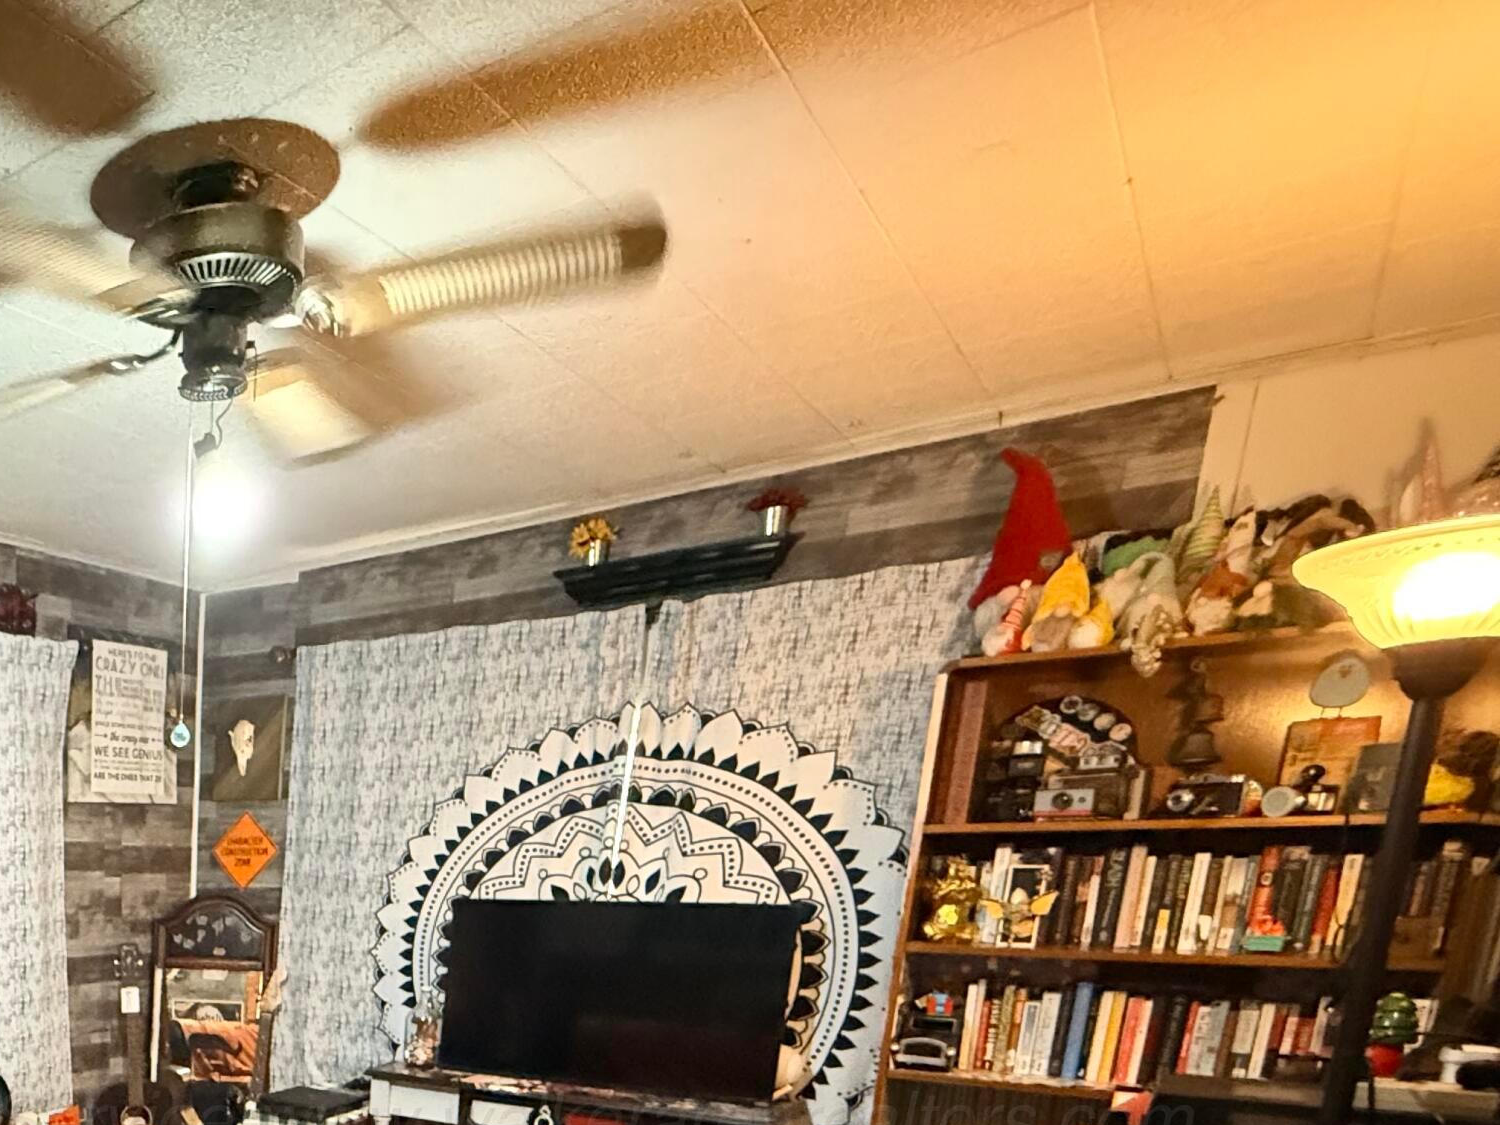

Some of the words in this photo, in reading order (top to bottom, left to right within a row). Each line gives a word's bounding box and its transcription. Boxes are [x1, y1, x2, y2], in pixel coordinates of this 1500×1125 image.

[95, 656, 136, 675] CRAZY
[94, 745, 109, 757] WE
[112, 746, 130, 759] SEE
[132, 748, 163, 761] GENIUS
